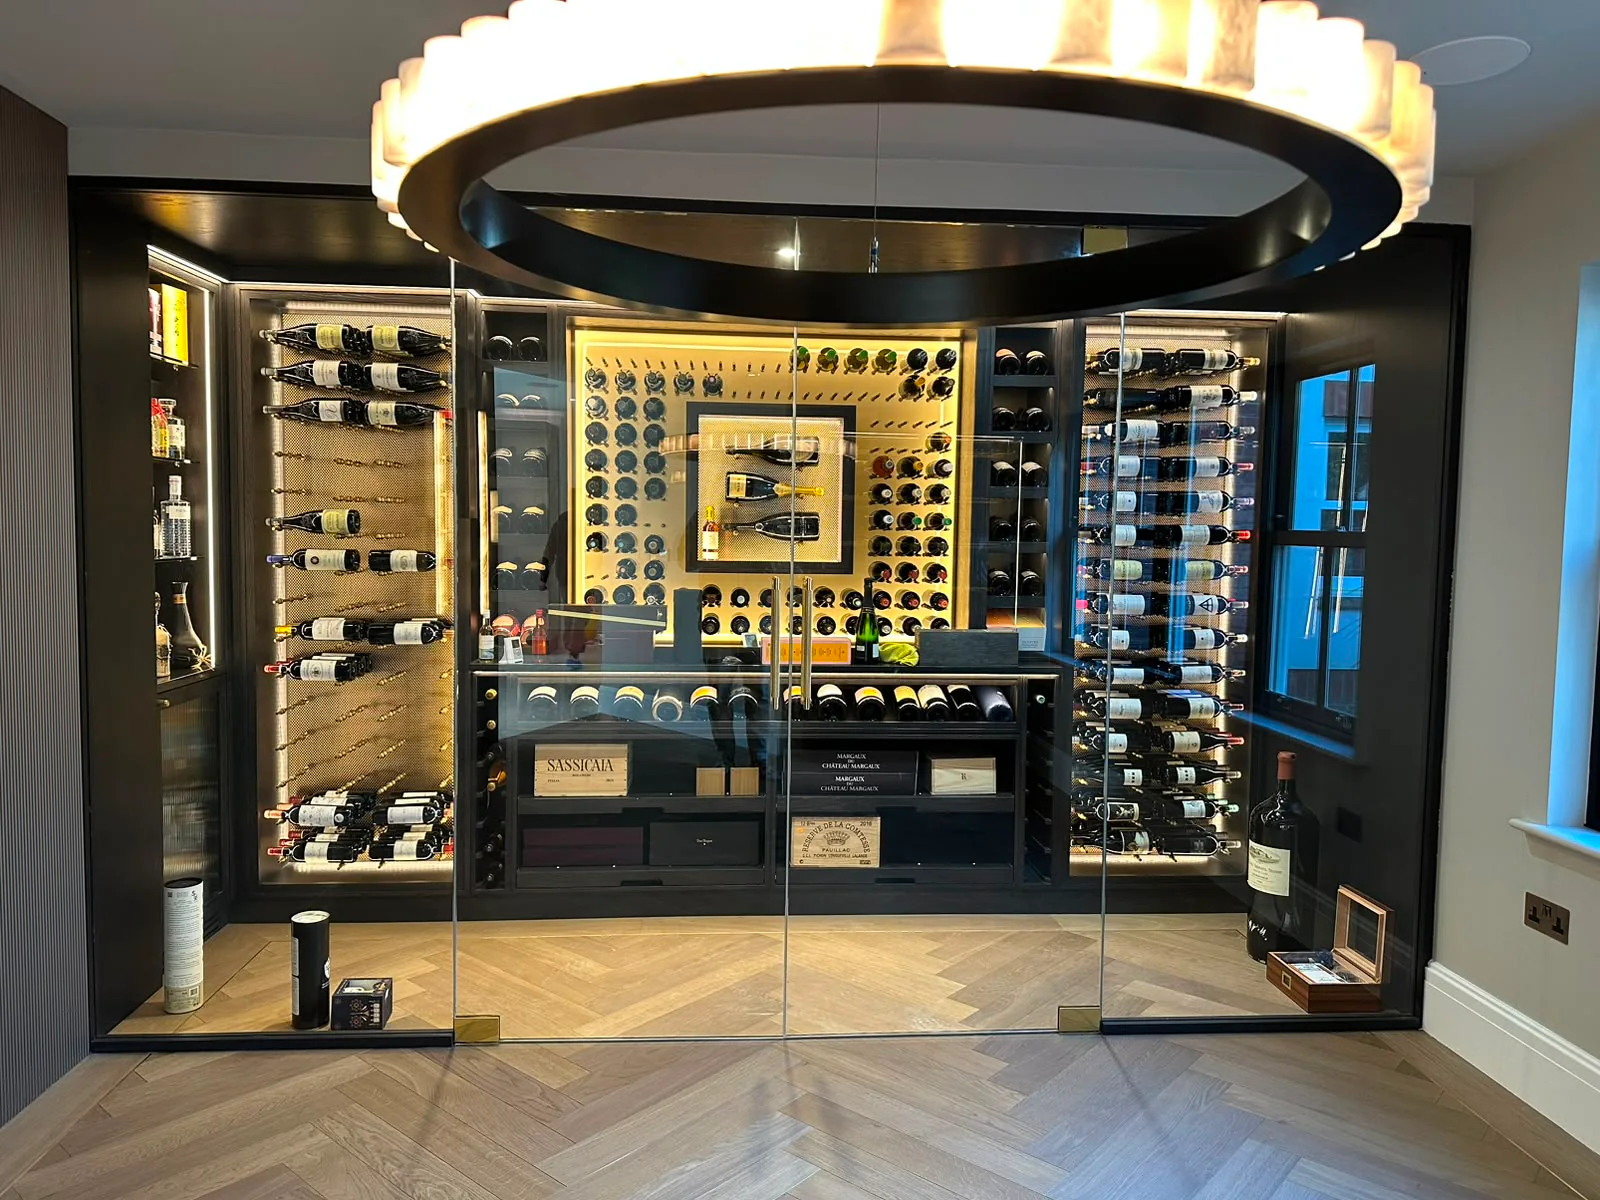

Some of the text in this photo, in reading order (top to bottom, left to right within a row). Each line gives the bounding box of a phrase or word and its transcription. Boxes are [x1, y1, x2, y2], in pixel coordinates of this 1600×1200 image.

[547, 758, 614, 772] SASSICAIA
[823, 821, 834, 830] DE
[834, 820, 844, 828] LA
[845, 822, 871, 853] COMTESSE
